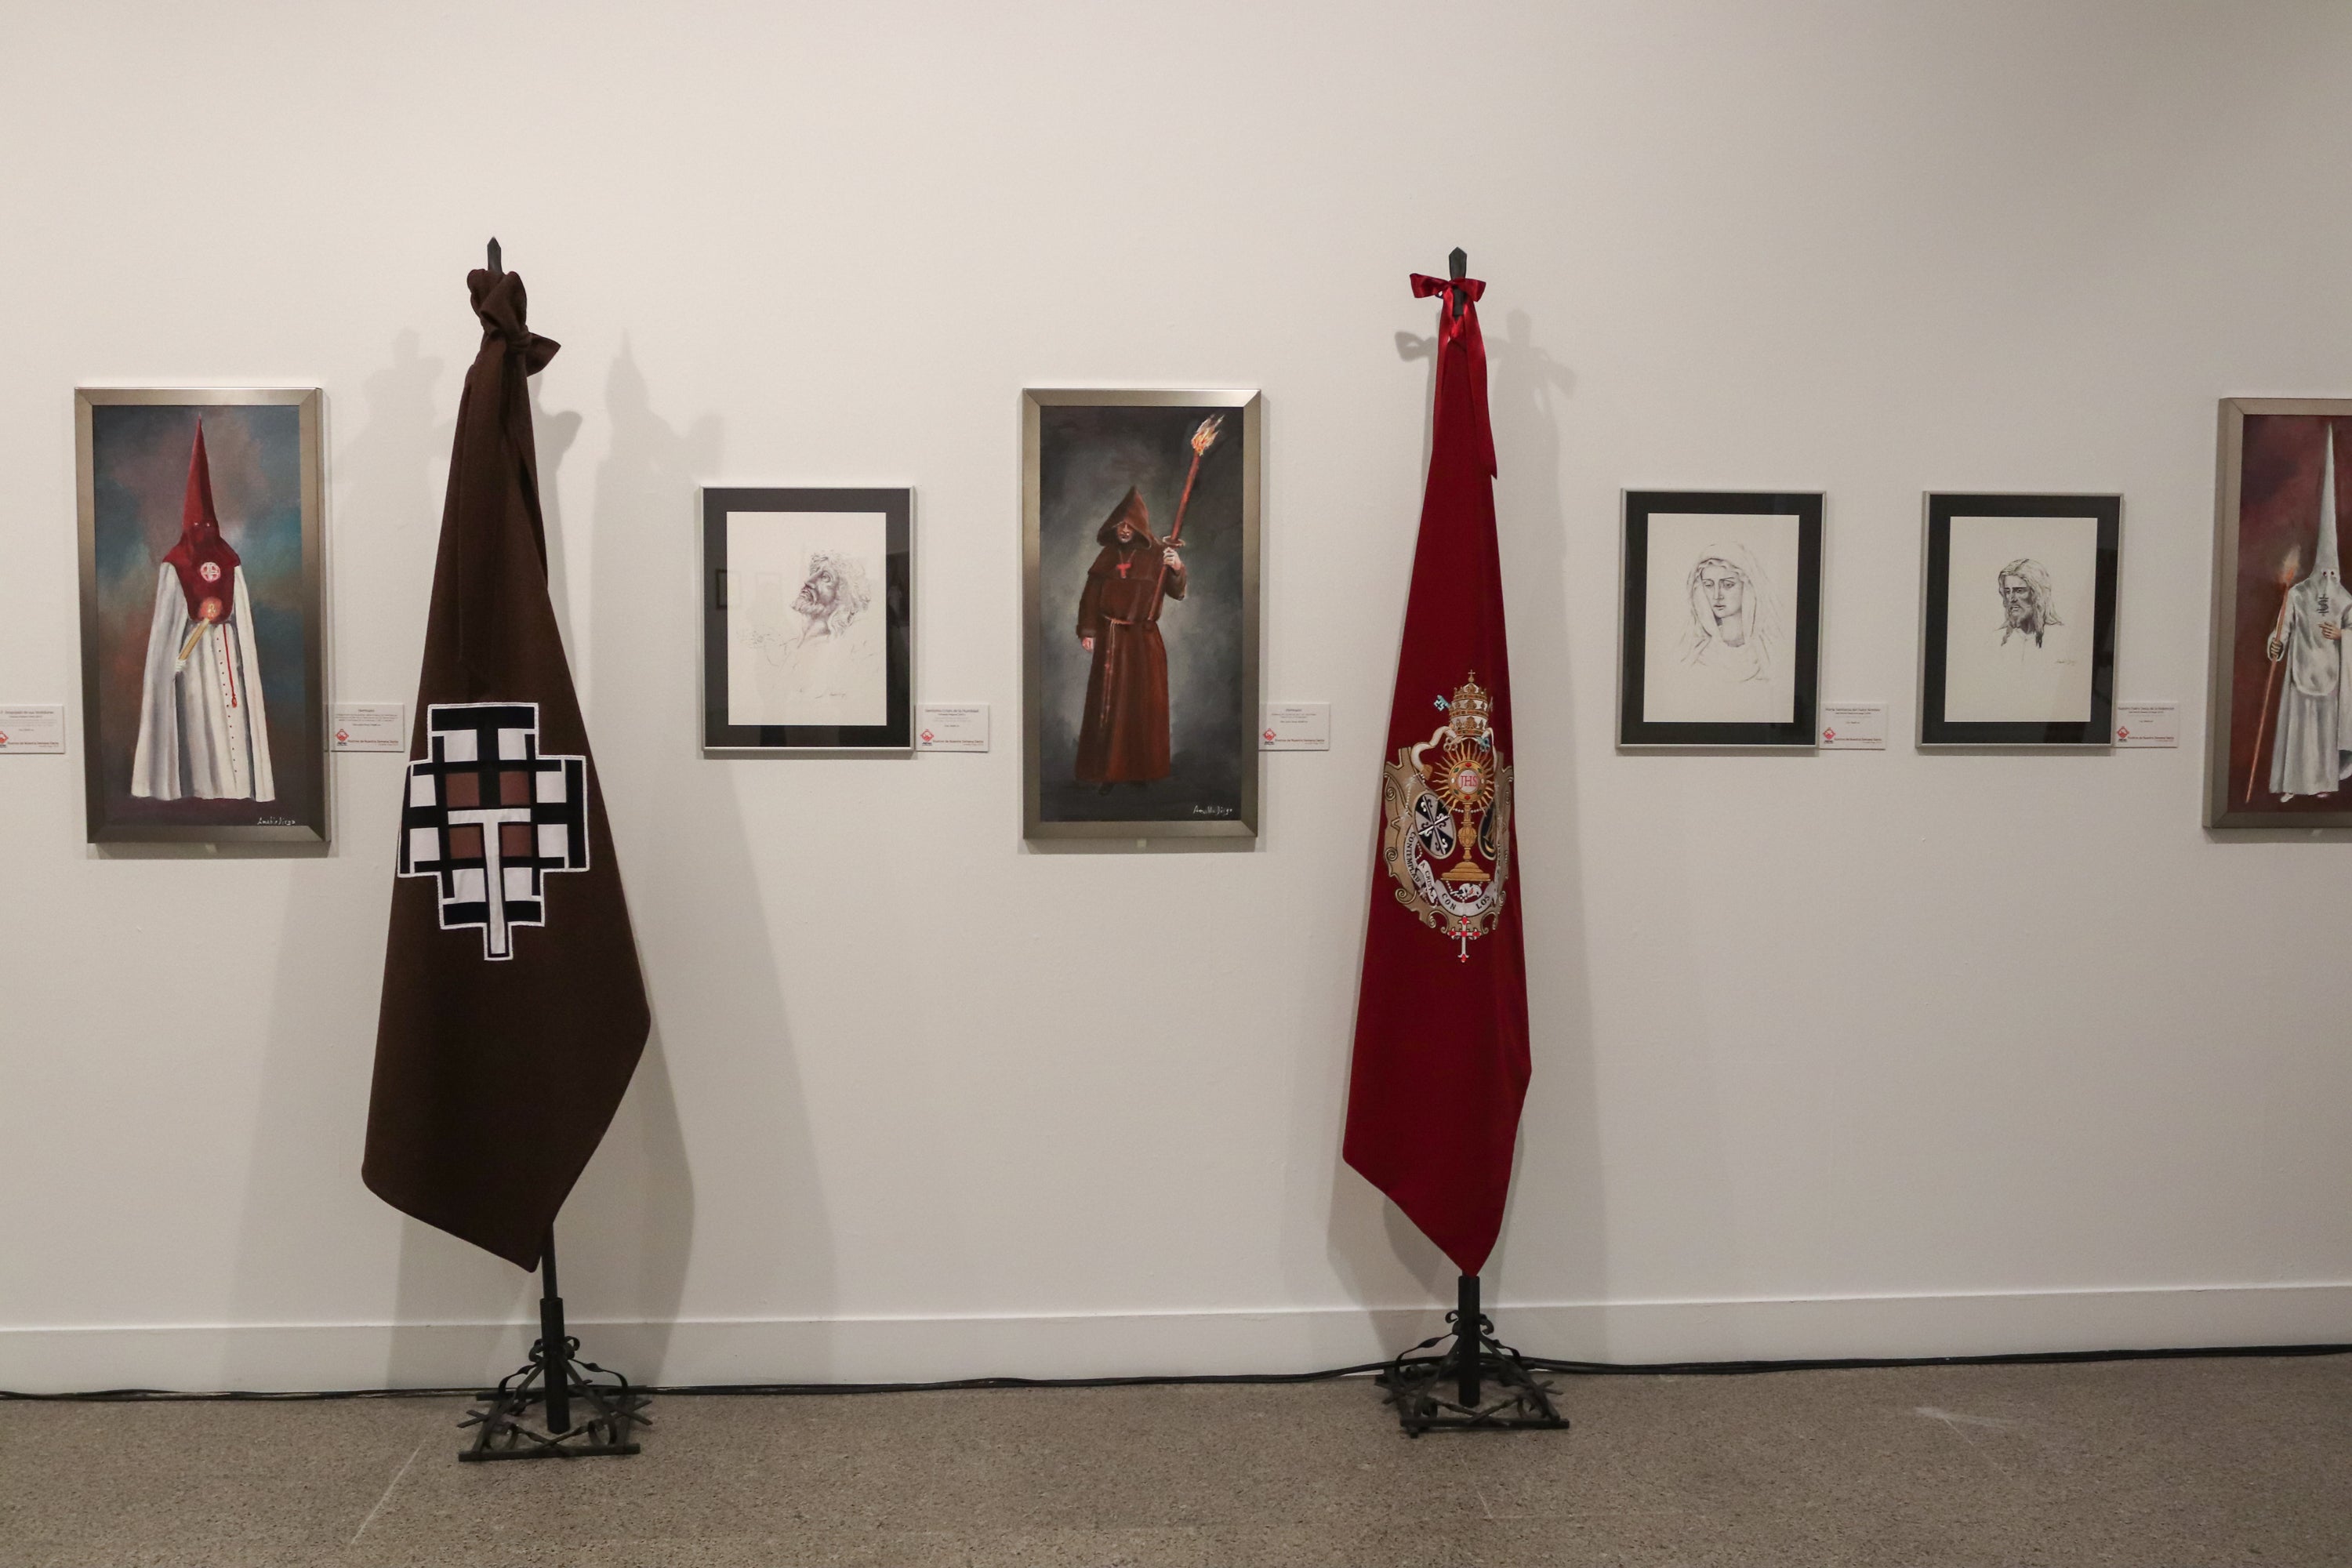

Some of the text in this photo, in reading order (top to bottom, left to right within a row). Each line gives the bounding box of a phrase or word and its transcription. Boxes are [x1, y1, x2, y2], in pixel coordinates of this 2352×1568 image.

[1406, 832, 1421, 883] CONTEMPLAD
[1442, 893, 1490, 910] CON LOS
